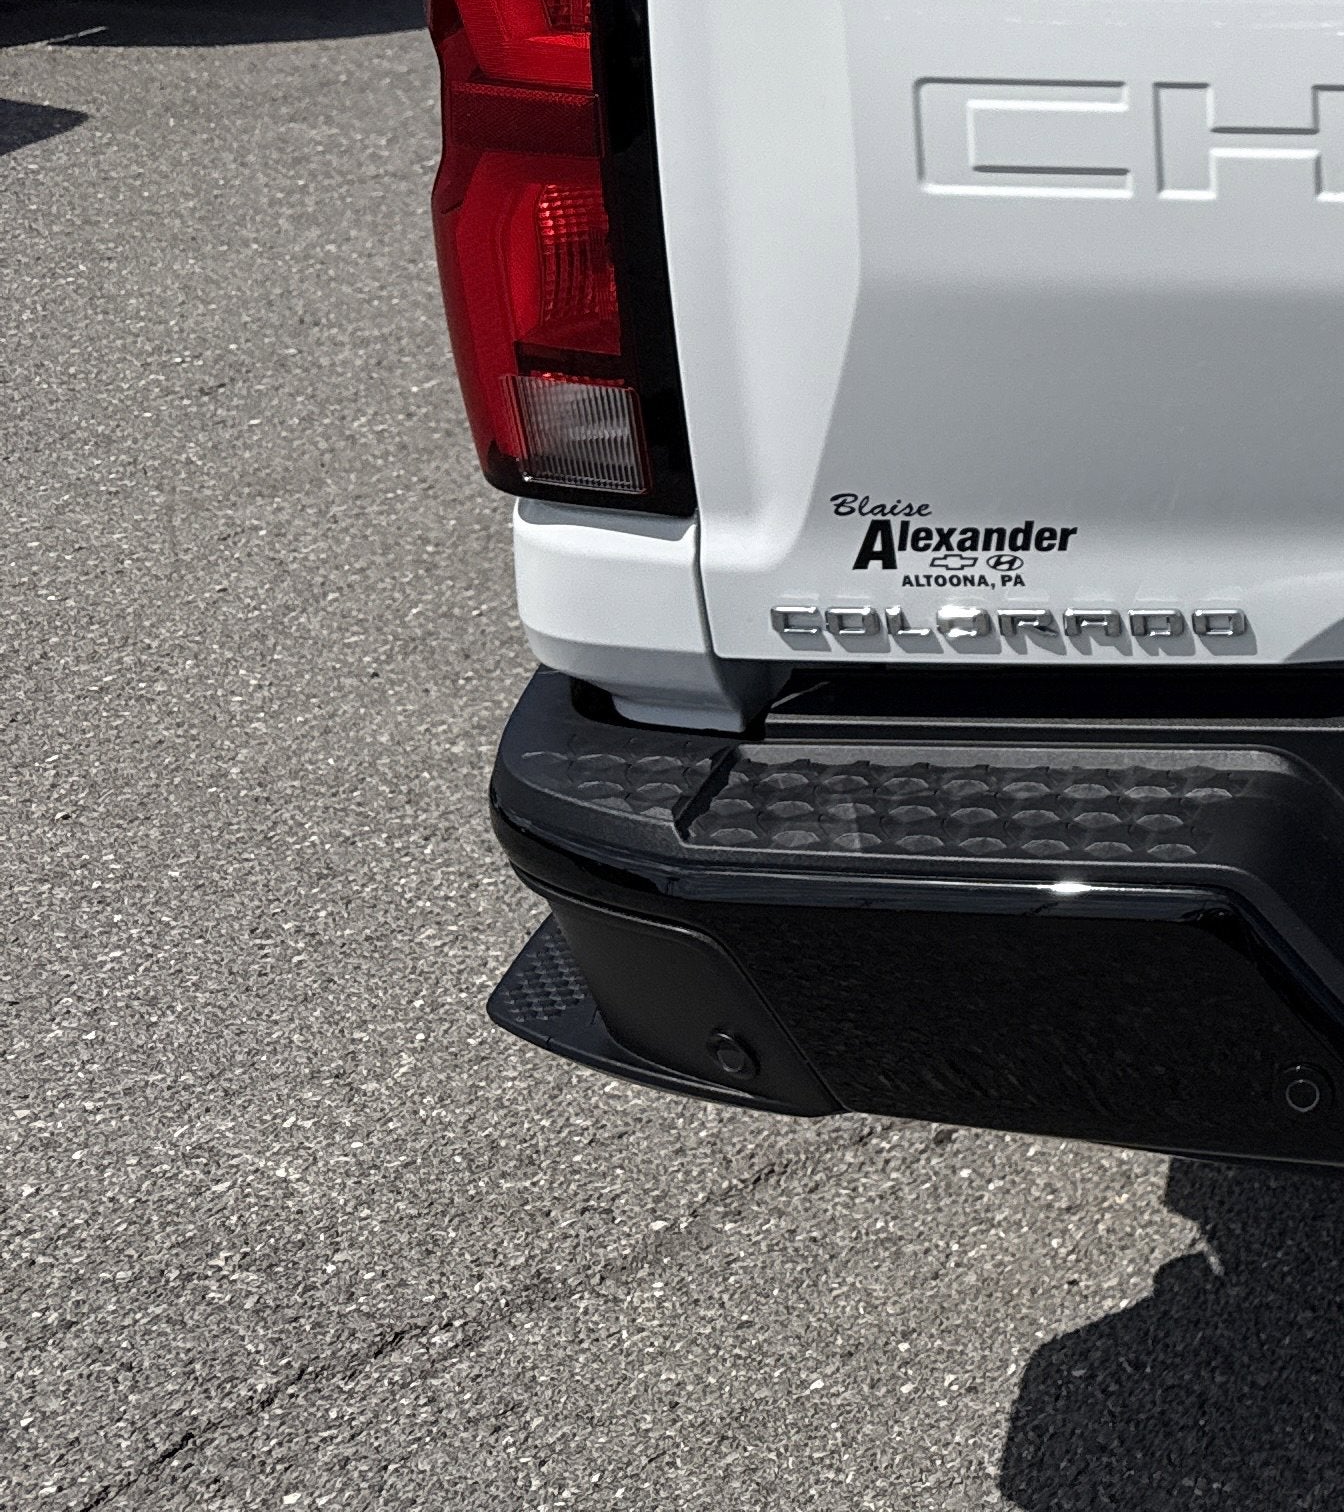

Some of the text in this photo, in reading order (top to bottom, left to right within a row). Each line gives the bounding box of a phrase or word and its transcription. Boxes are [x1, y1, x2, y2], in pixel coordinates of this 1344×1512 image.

[830, 493, 932, 518] Blaise
[852, 518, 1078, 571] Alexander
[901, 573, 1026, 590] ALTOONA, PA
[770, 604, 1247, 638] COLORADO
